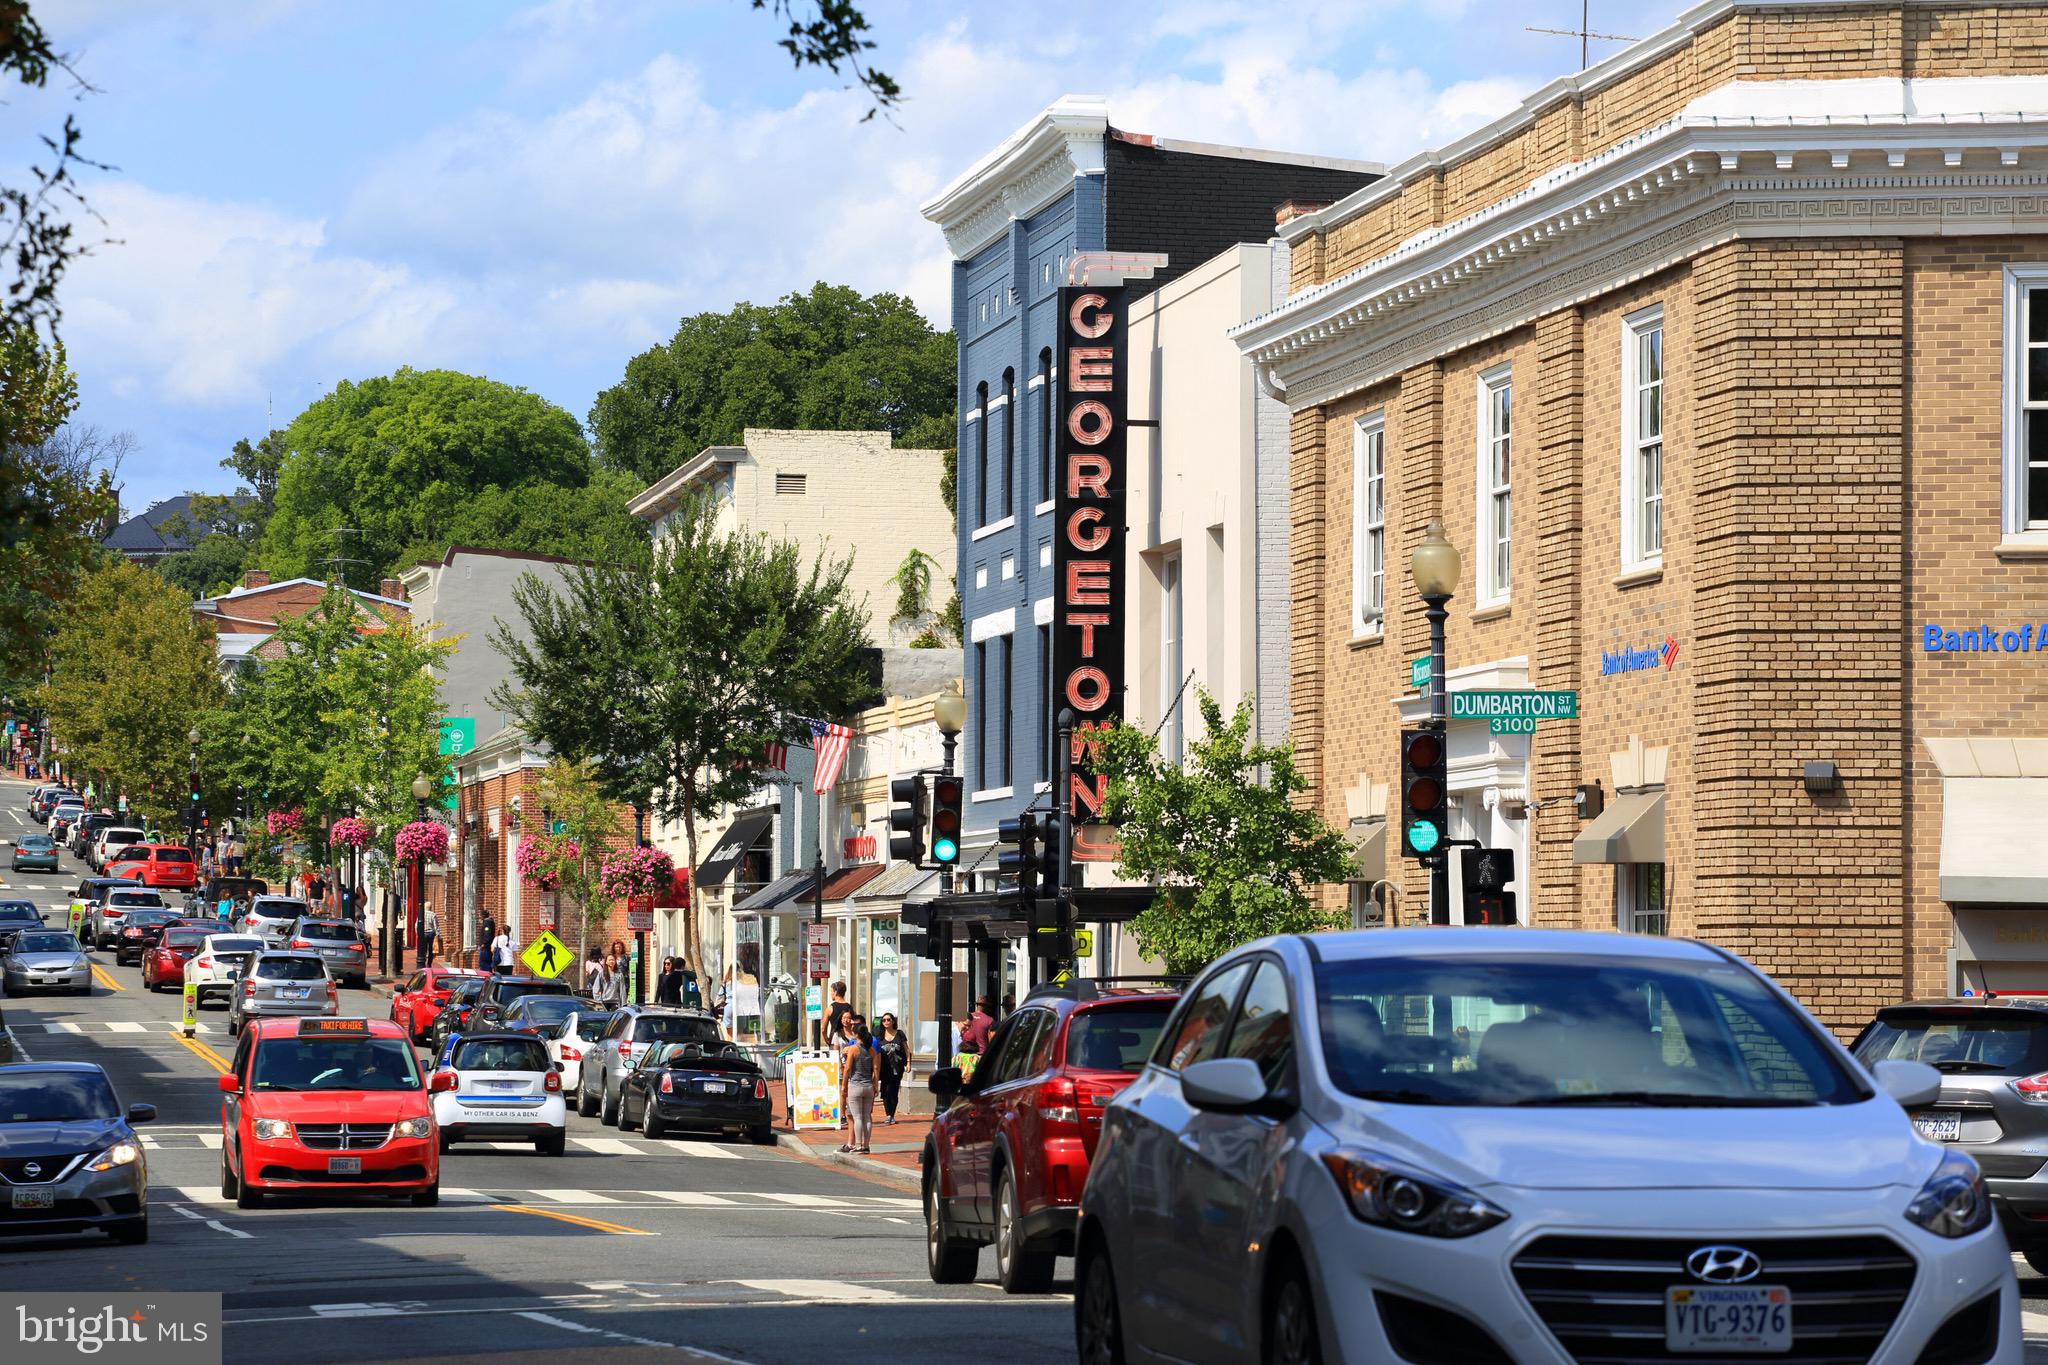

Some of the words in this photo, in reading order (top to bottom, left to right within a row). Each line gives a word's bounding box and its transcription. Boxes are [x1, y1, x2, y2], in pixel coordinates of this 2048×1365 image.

[1066, 293, 1114, 818] GEORGETOWN
[1923, 624, 1999, 652] Bank
[2001, 623, 2032, 652] of
[1601, 650, 1620, 676] Bank
[1620, 648, 1628, 673] of
[1627, 645, 1659, 671] America
[1453, 695, 1556, 715] DUMBARTON
[1558, 696, 1571, 705] ST
[1558, 706, 1571, 714] NW
[1492, 718, 1534, 732] 3100
[878, 920, 896, 930] FO
[877, 936, 897, 945] (301
[875, 954, 898, 966] NRE
[320, 1021, 334, 1030] TAXI
[335, 1021, 348, 1030] FOR
[348, 1021, 363, 1030] HIRE
[1699, 1290, 1759, 1302] VIRGINIA
[1675, 1304, 1786, 1334] VTG-9376
